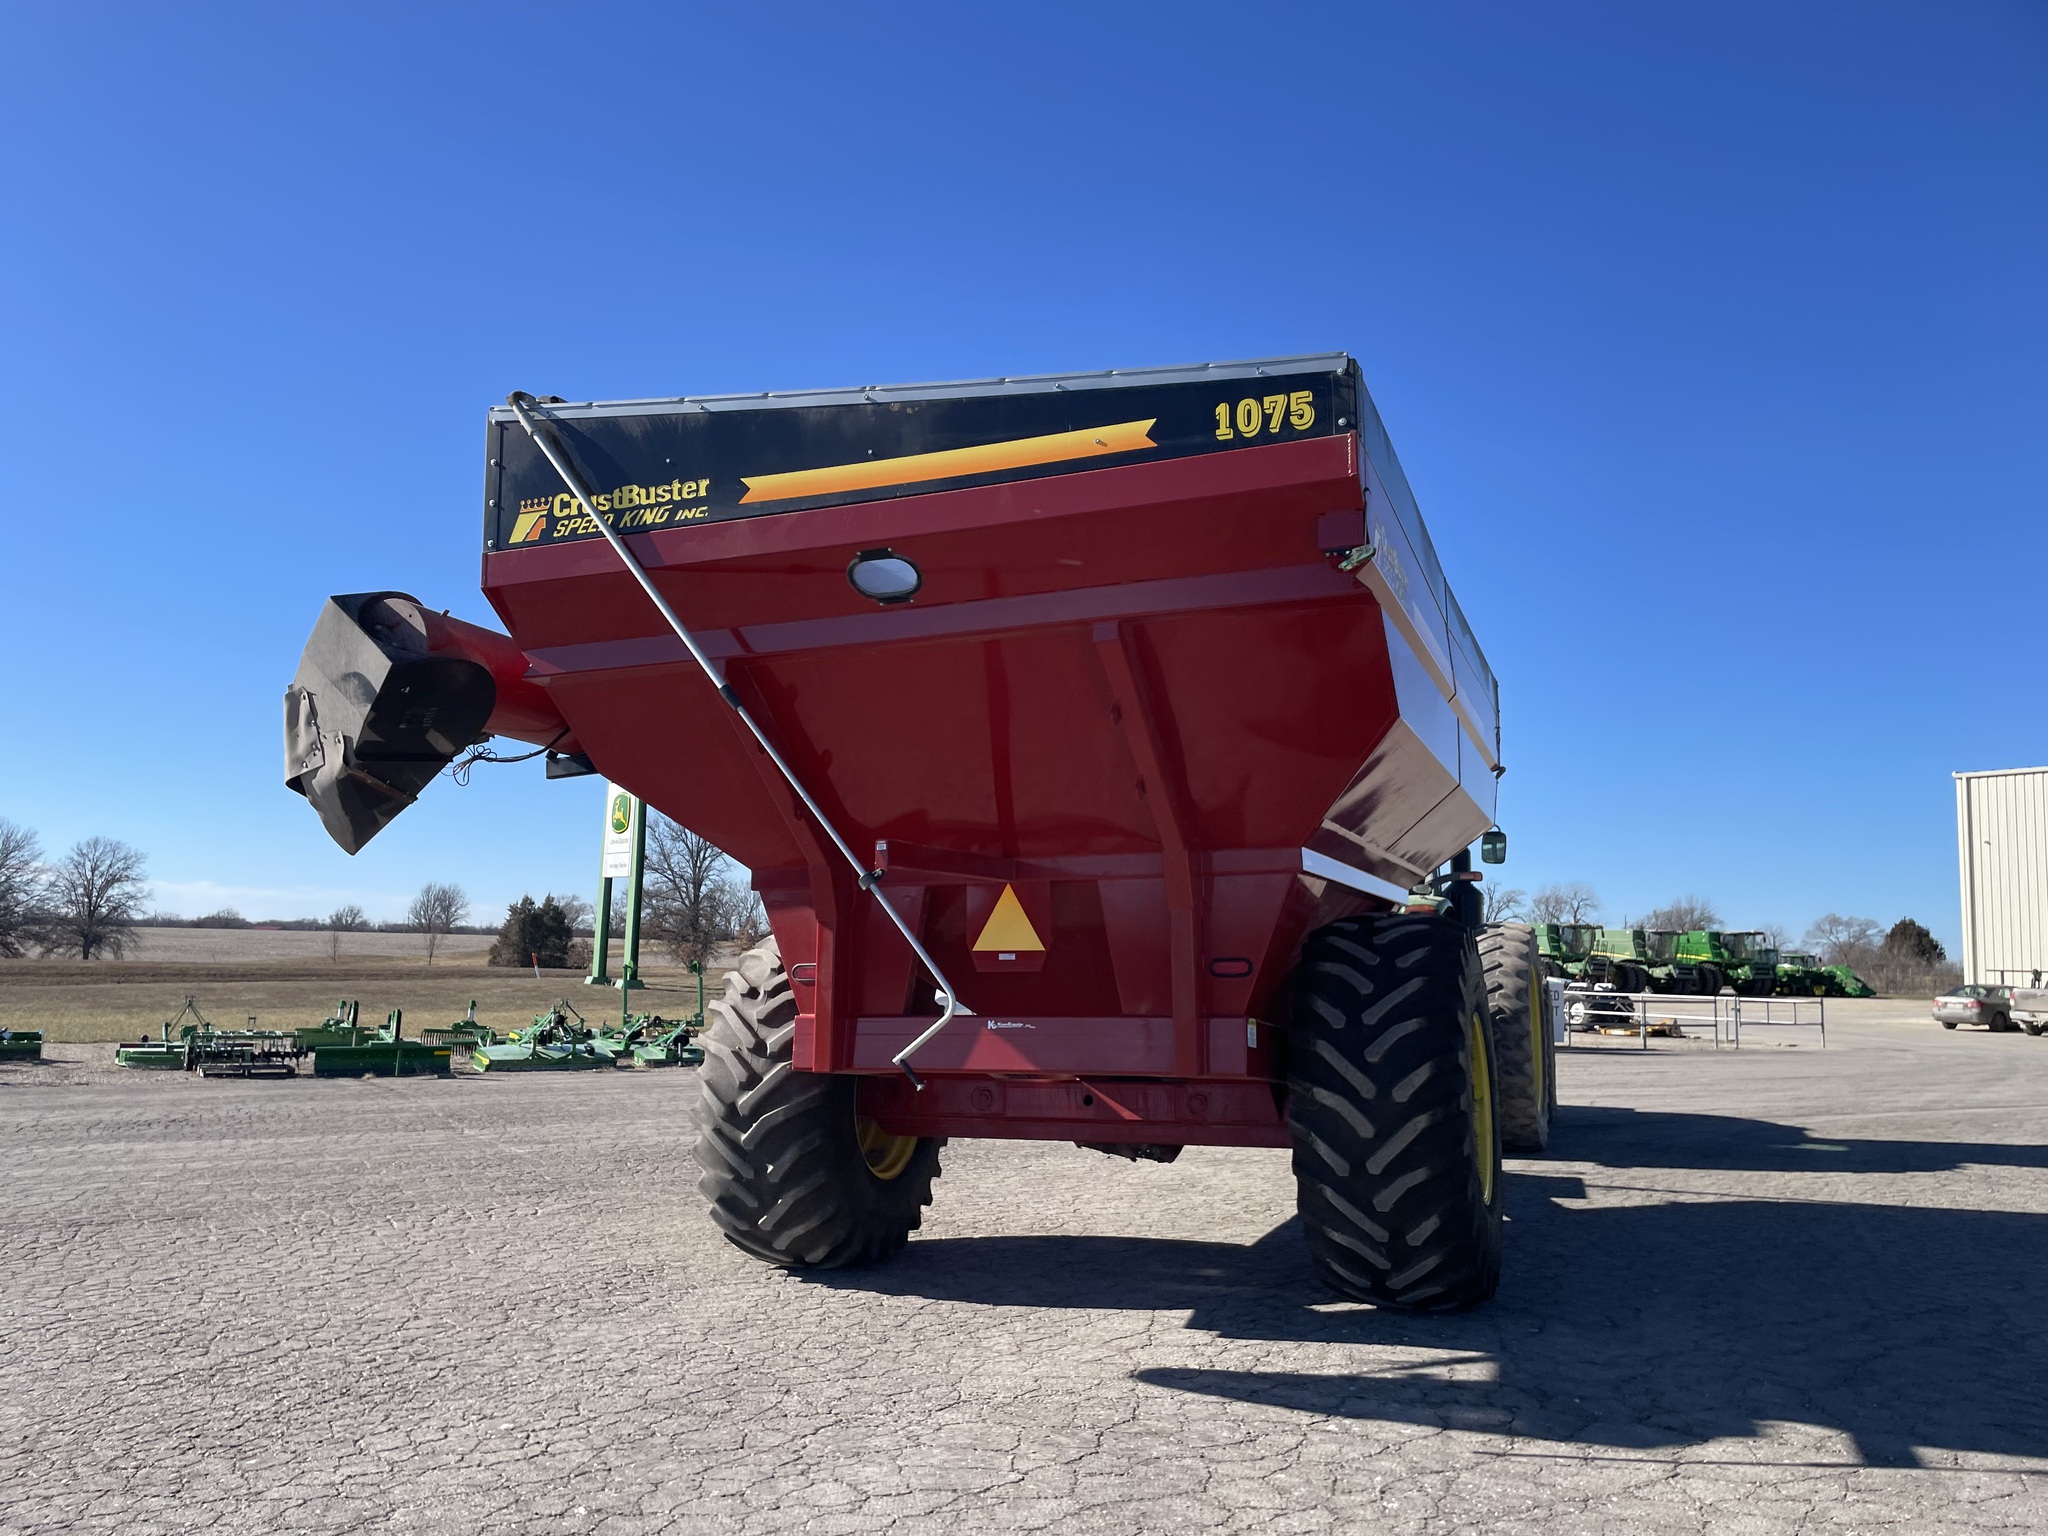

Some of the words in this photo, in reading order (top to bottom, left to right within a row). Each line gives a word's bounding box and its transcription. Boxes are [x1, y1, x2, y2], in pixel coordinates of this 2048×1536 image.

[1215, 390, 1315, 440] 1075
[618, 505, 673, 528] KING
[674, 506, 708, 521] INC.
